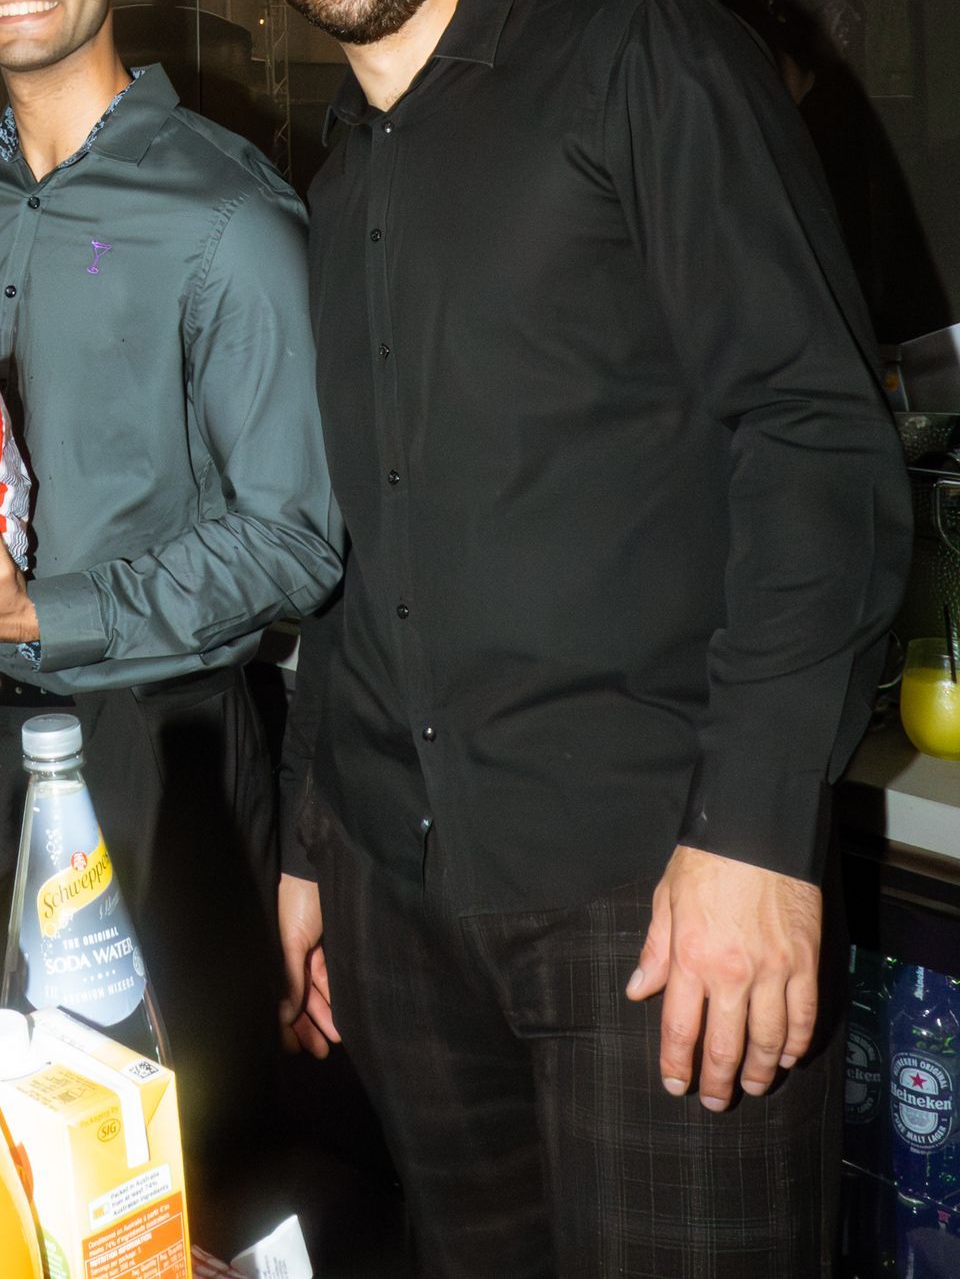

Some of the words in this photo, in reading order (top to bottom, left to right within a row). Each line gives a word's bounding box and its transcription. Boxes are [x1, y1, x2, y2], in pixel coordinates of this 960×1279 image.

[83, 926, 119, 946] ORIGINAL
[45, 952, 91, 975] SODA
[93, 936, 134, 964] WATER
[891, 1081, 953, 1112] Heineken
[100, 1122, 118, 1140] SIG
[906, 1130, 926, 1144] MALT
